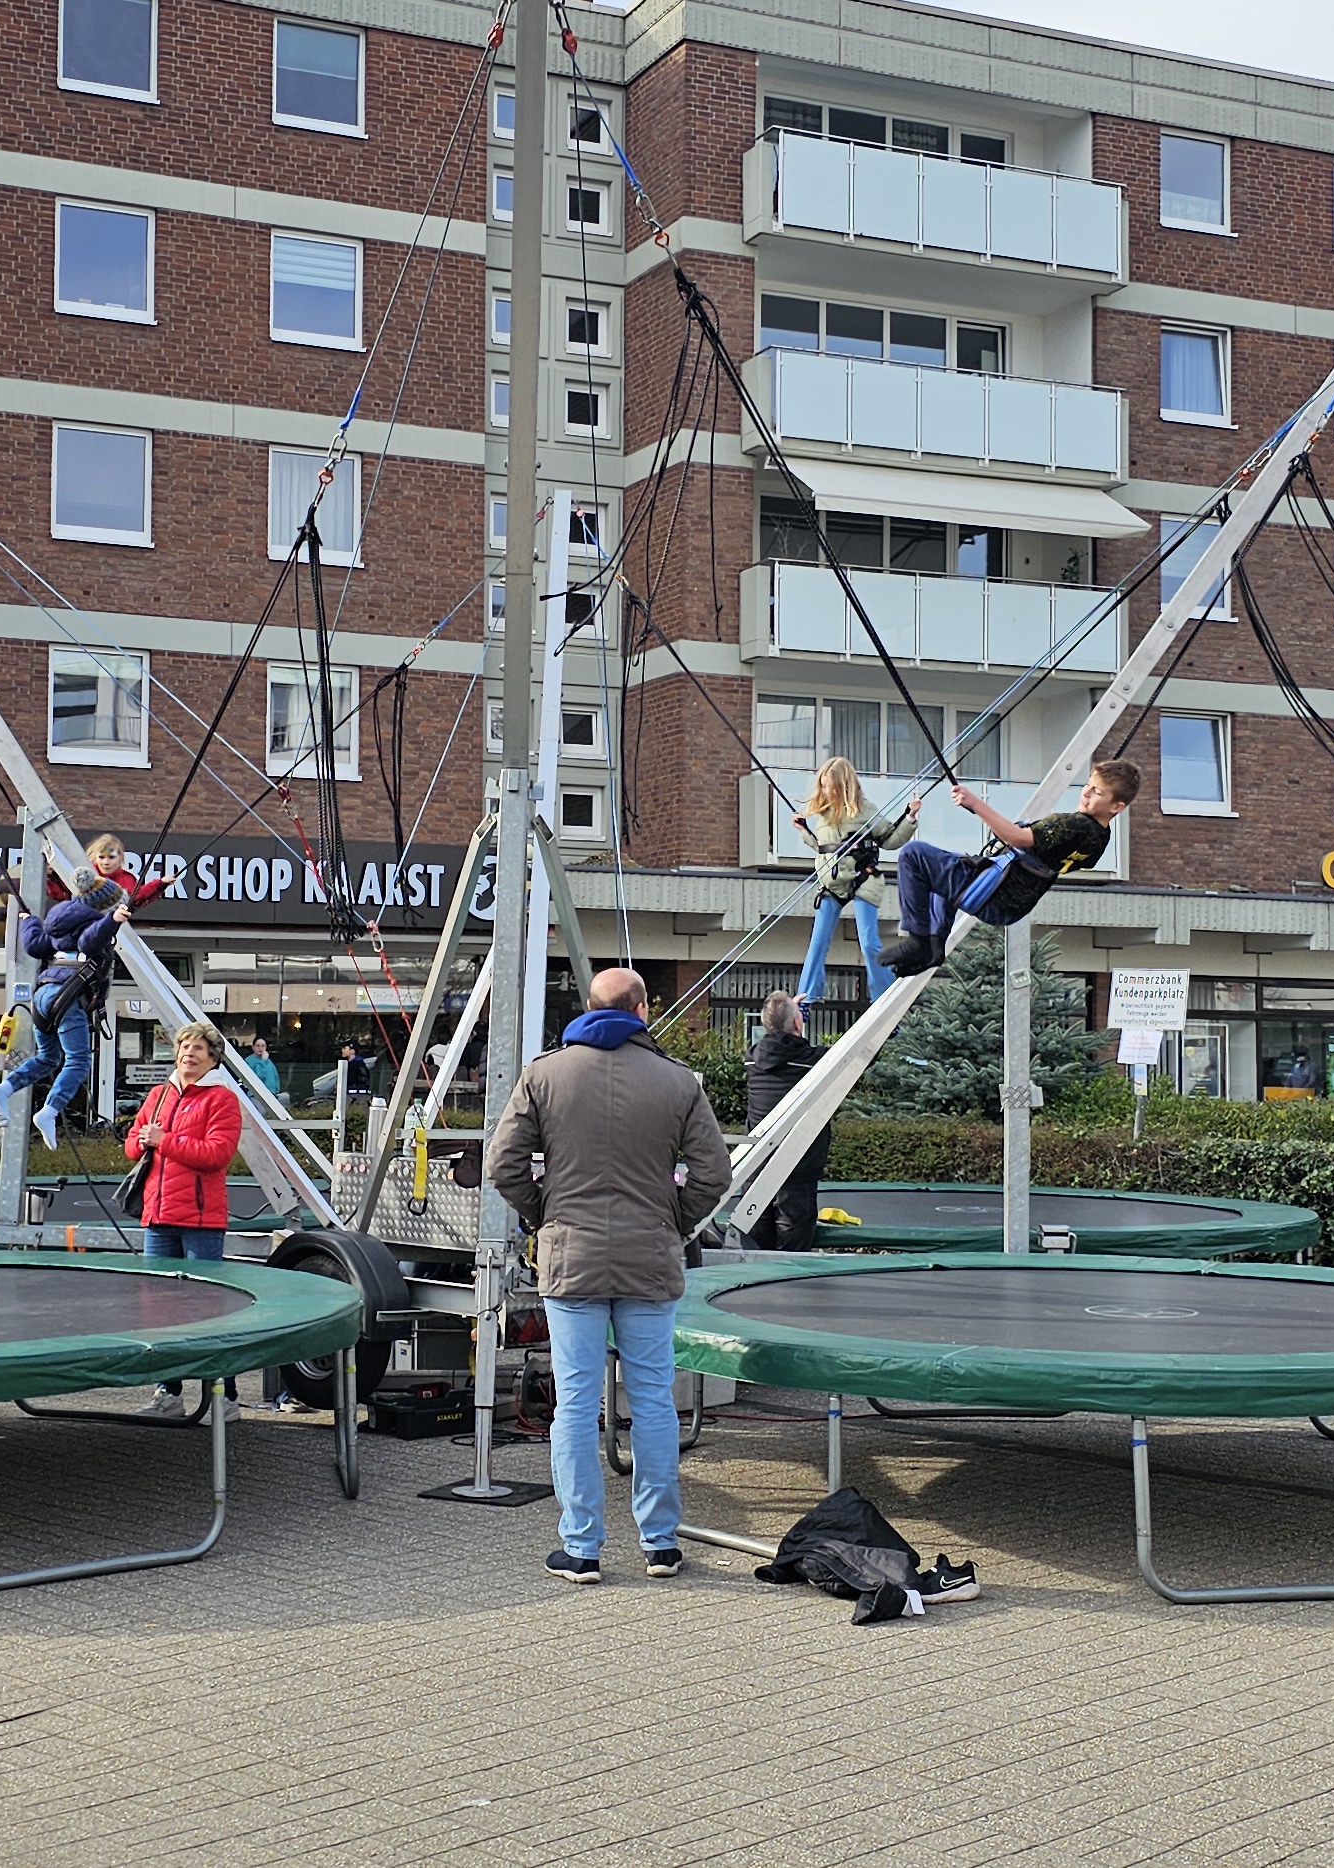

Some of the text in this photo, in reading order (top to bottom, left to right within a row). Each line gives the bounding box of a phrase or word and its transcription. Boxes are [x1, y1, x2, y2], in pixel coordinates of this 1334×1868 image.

[196, 854, 294, 903] SHOP
[1118, 973, 1182, 985] Commerzbank
[1114, 987, 1184, 1001] Kundenparkplatz
